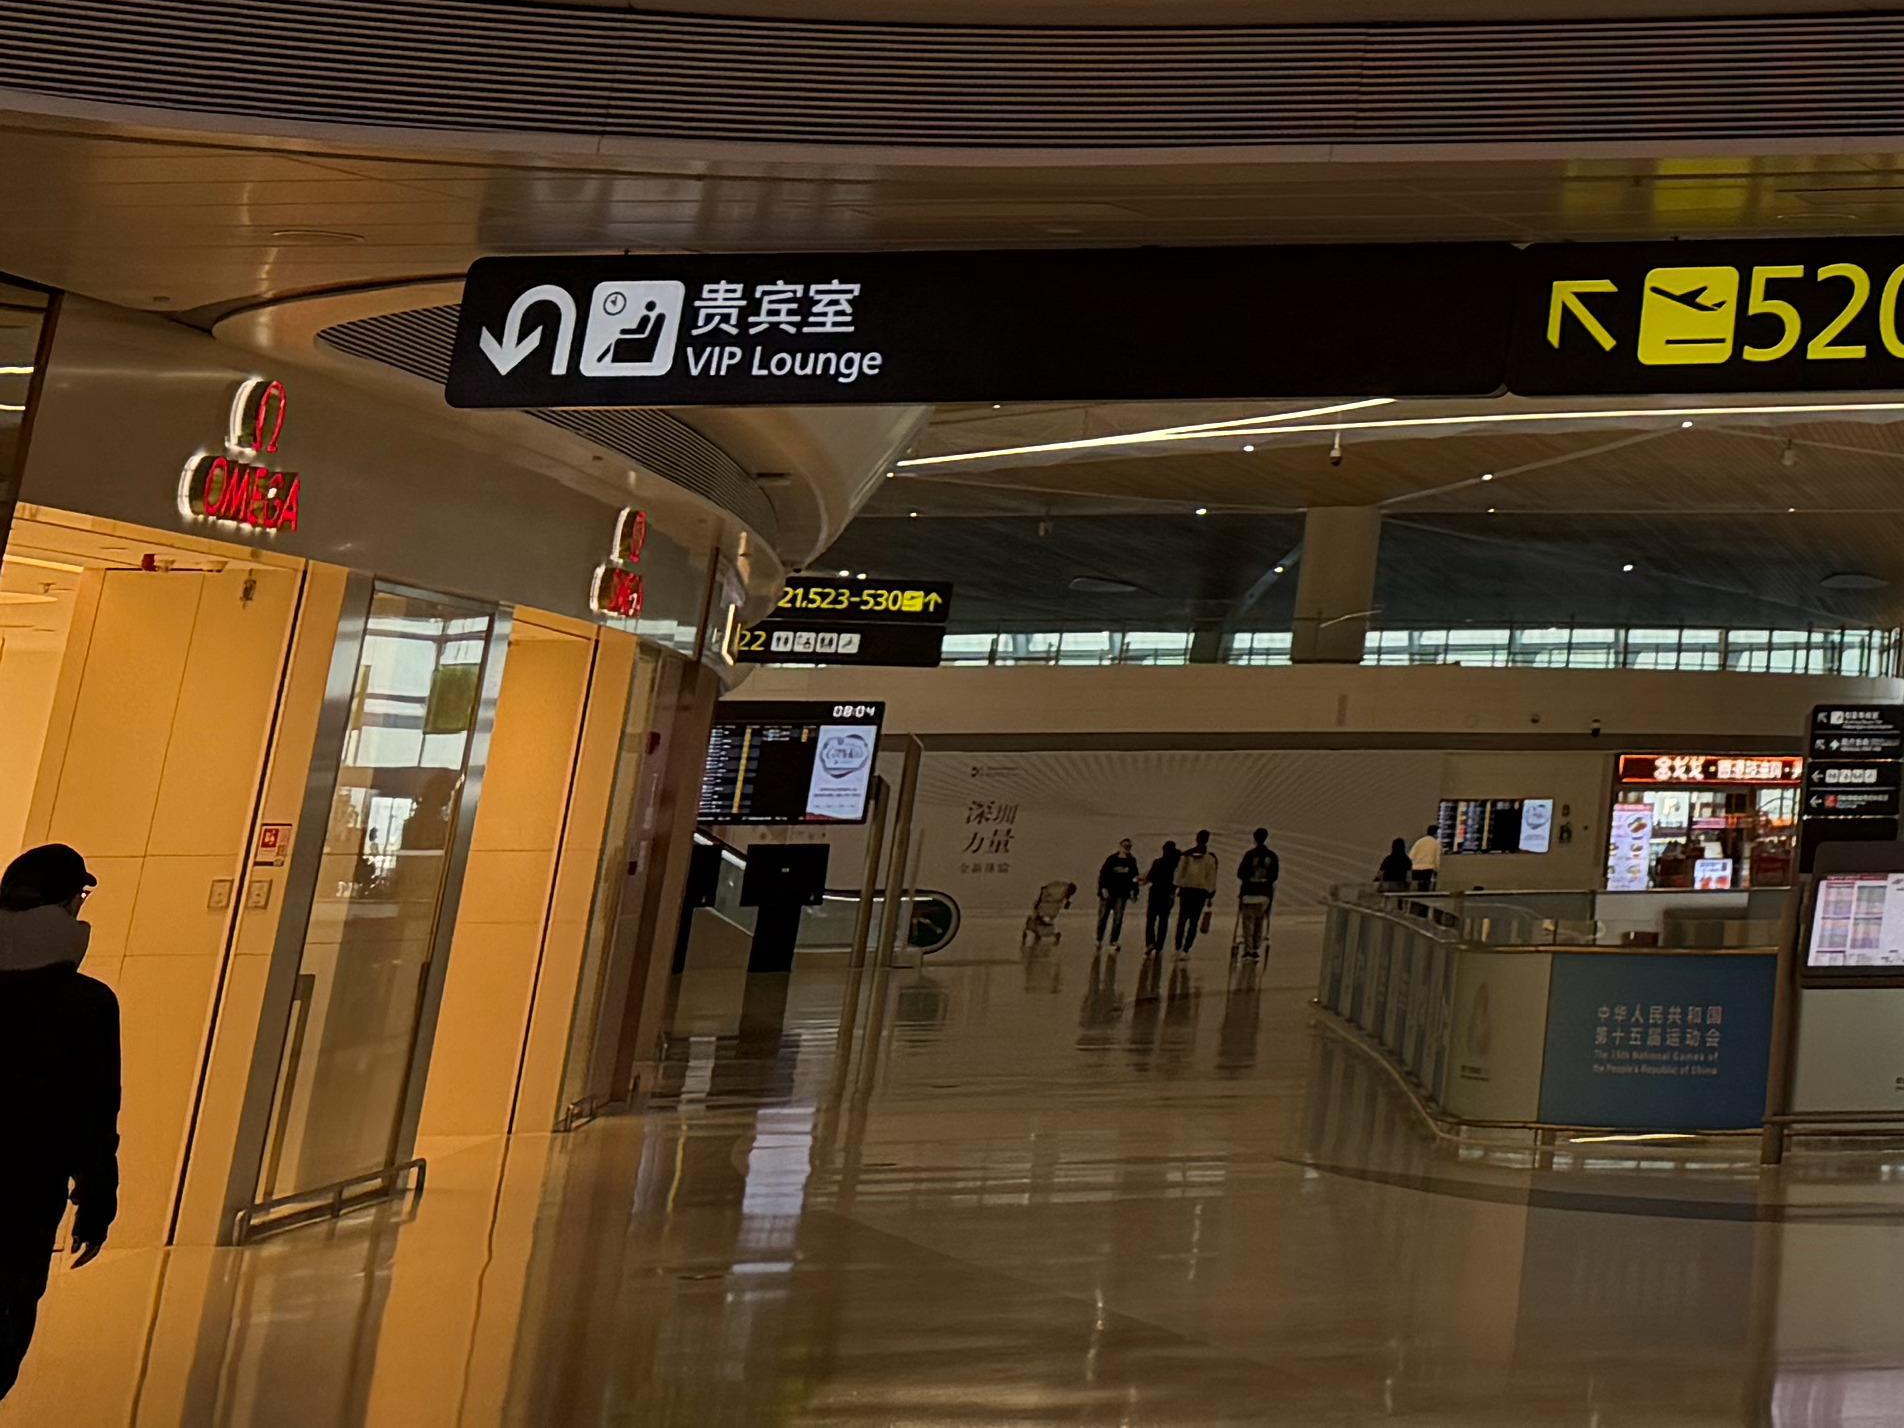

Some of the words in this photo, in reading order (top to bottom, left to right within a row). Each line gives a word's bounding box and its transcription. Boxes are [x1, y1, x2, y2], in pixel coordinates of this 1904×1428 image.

[690, 279, 861, 337] 贵宾室
[685, 347, 743, 376] VIP
[750, 345, 884, 384] Lounge
[190, 453, 301, 533] OMEGA
[966, 800, 1019, 825] 深圳
